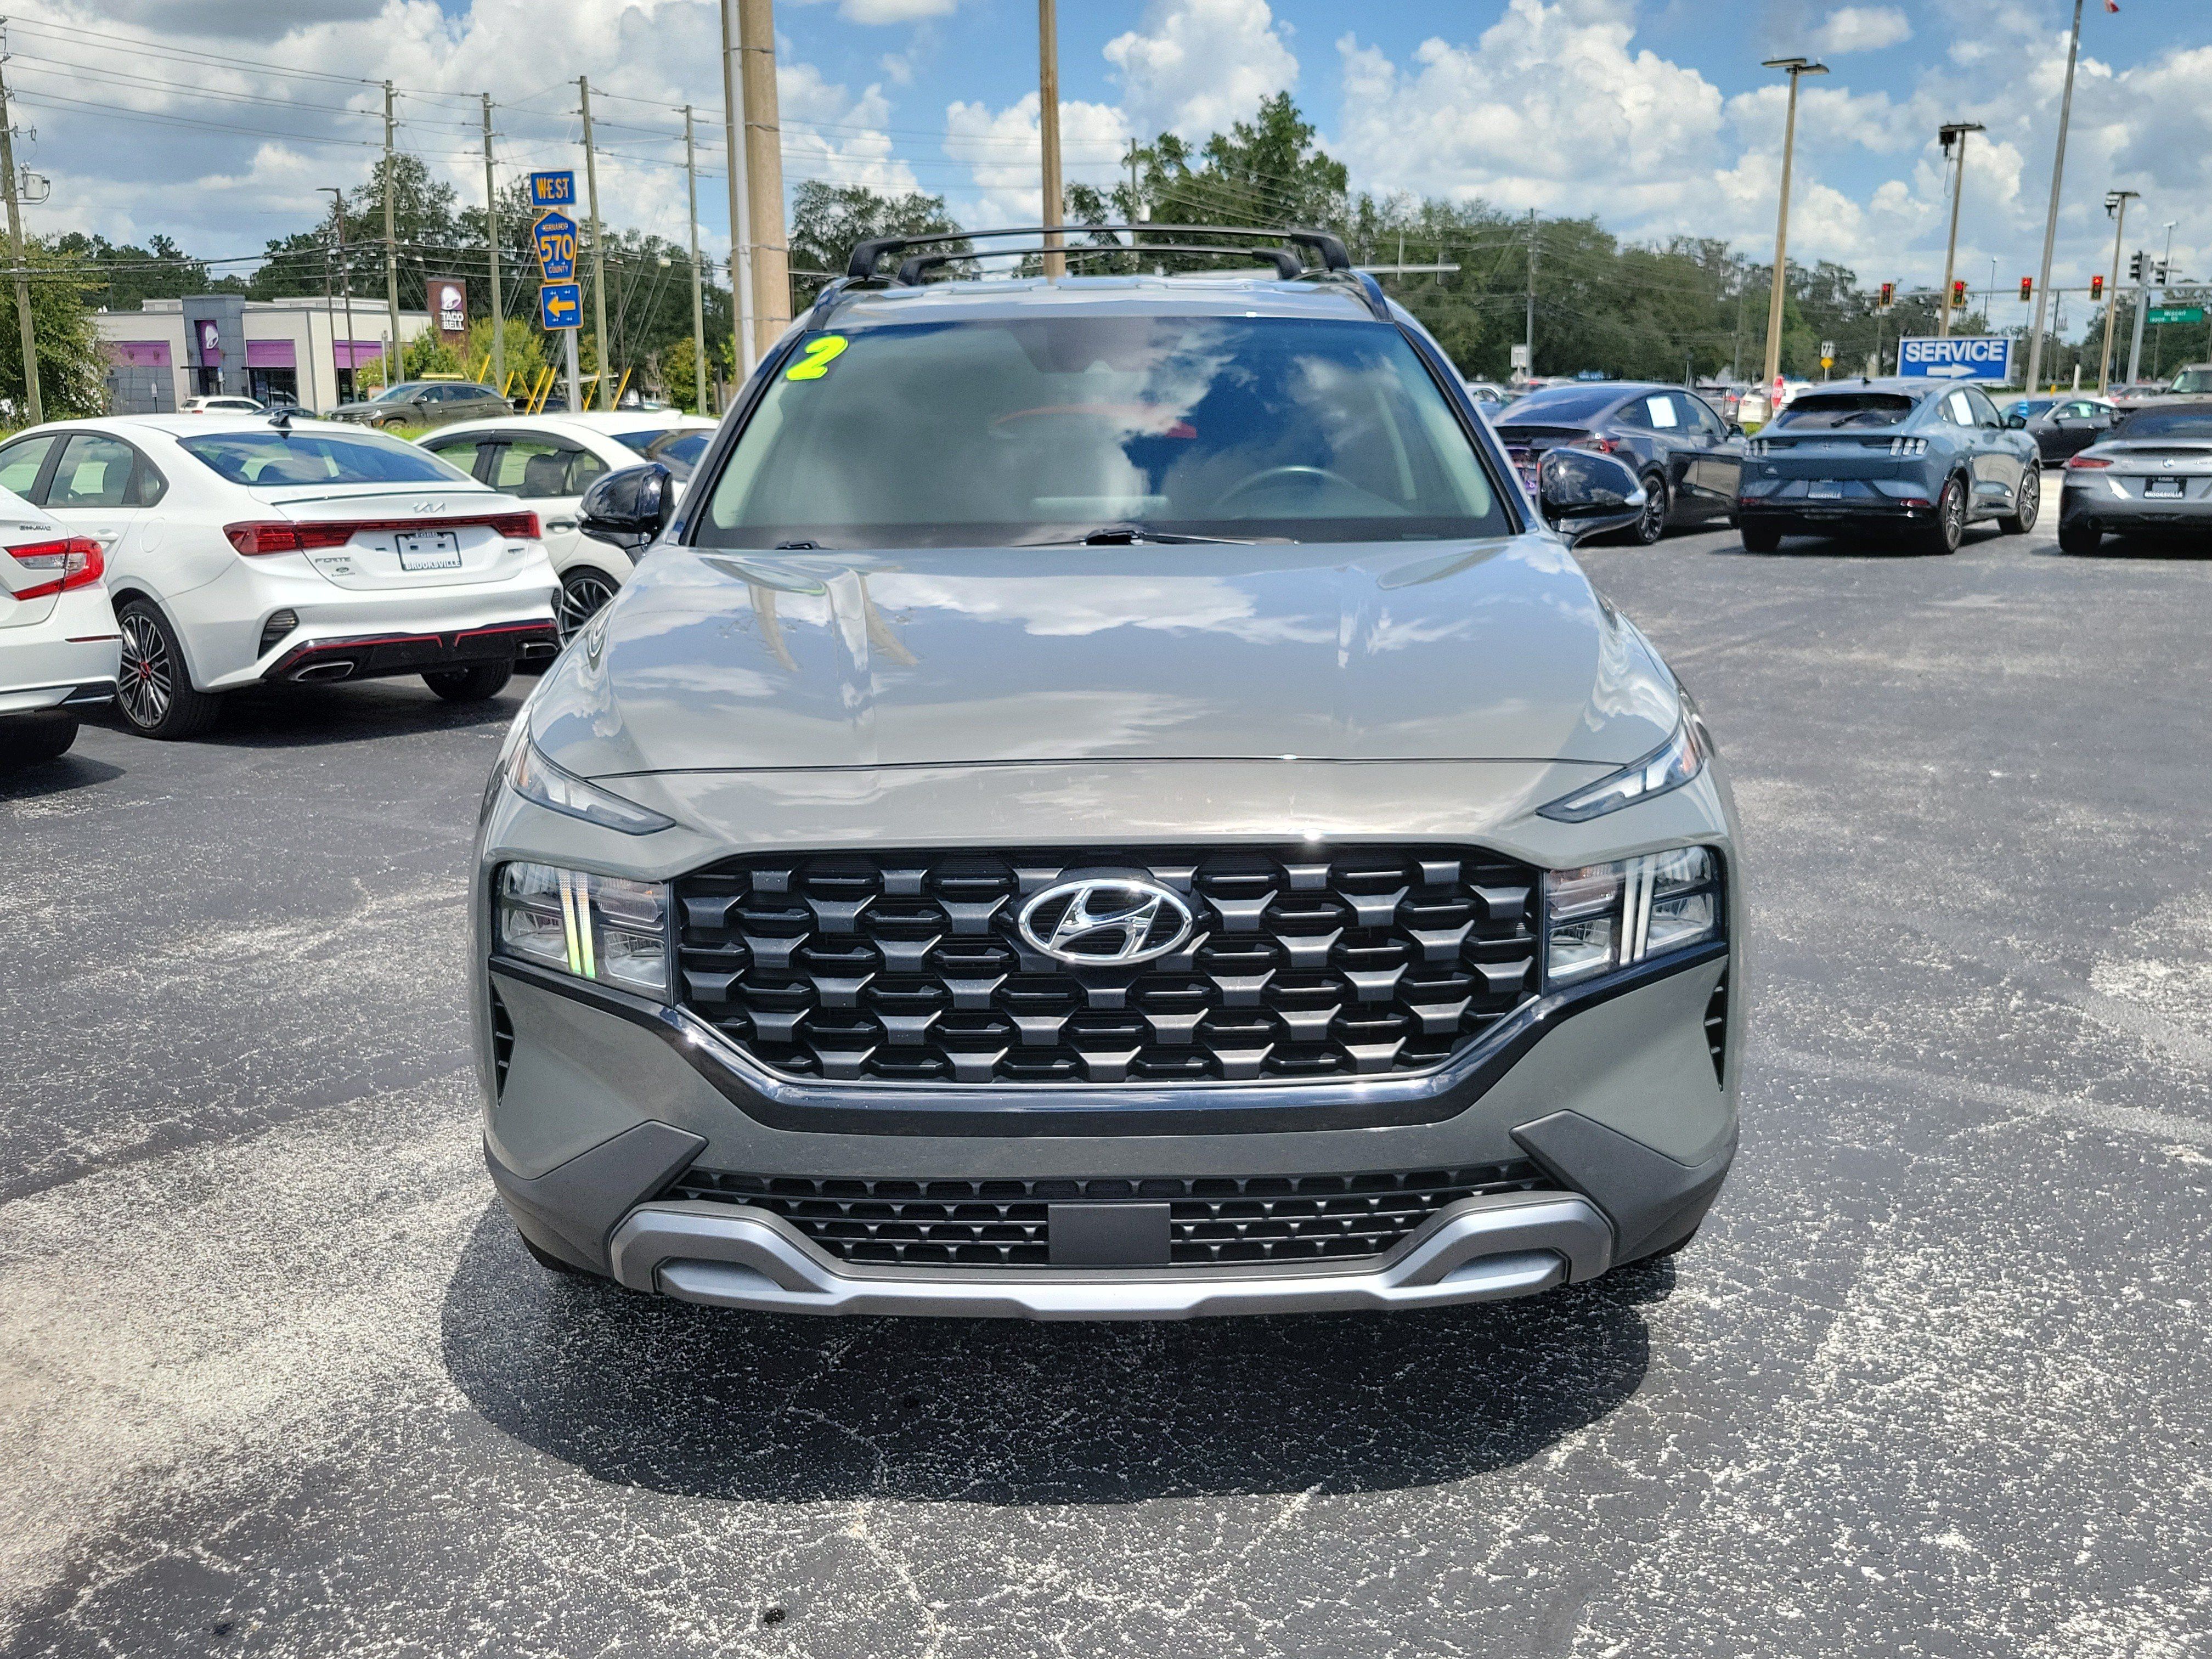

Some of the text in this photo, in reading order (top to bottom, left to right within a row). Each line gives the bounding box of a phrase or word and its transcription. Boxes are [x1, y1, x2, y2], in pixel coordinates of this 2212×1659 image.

[536, 177, 569, 199] WEST
[540, 234, 574, 262] 570
[548, 265, 568, 274] COUNTY
[439, 310, 464, 322] TACO
[442, 321, 464, 330] BELL
[786, 335, 849, 381] 2
[1905, 340, 2004, 363] SERVICE
[405, 560, 461, 569] BROOKSVILLE
